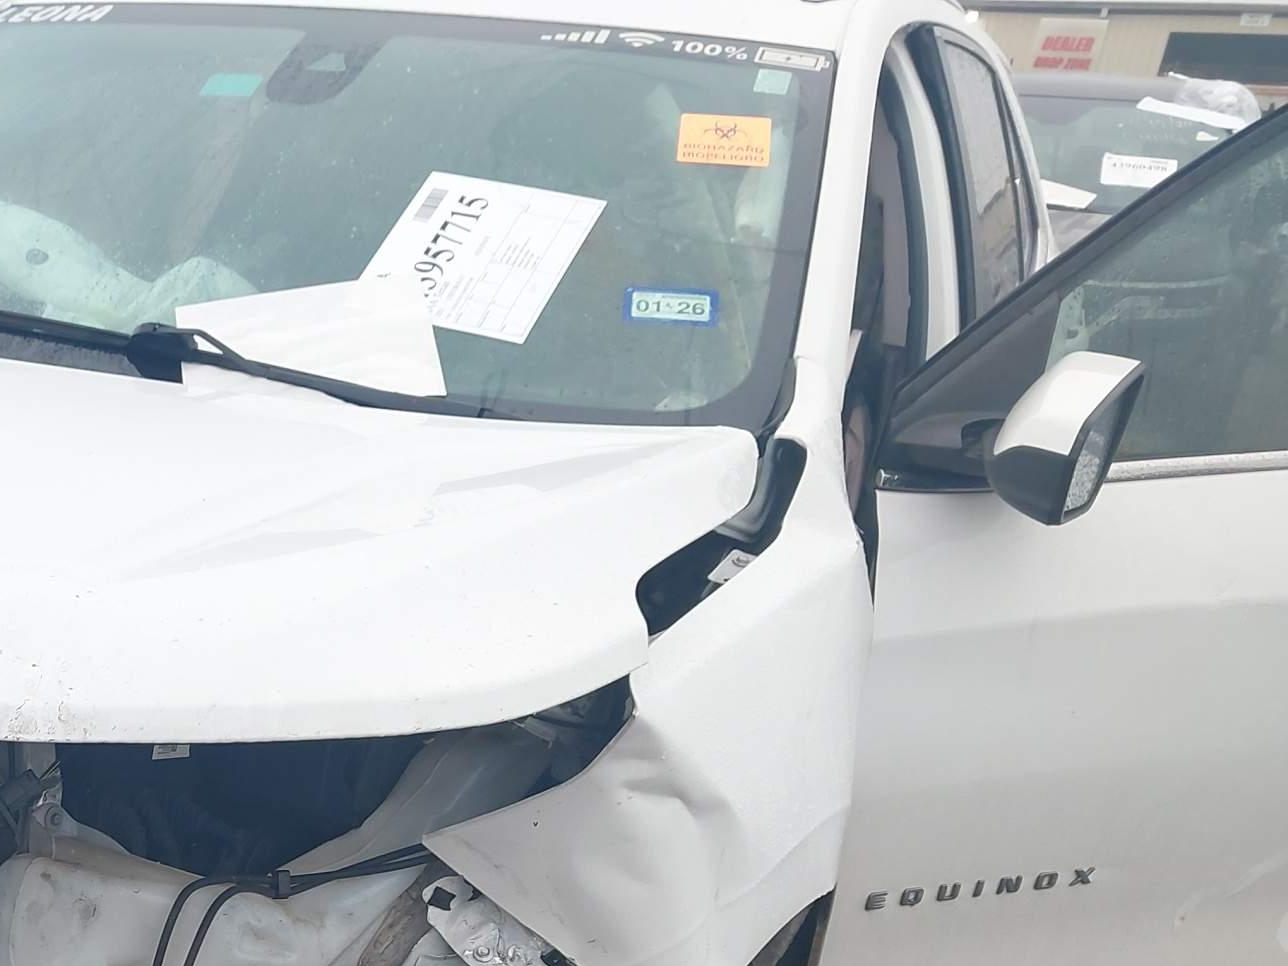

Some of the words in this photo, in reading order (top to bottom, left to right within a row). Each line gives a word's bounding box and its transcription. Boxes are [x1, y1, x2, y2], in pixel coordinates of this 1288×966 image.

[672, 40, 748, 61] 100%
[1041, 36, 1096, 52] DEALER
[636, 299, 661, 313] 01
[677, 301, 705, 316] 26
[864, 867, 1096, 911] EQUINOX
